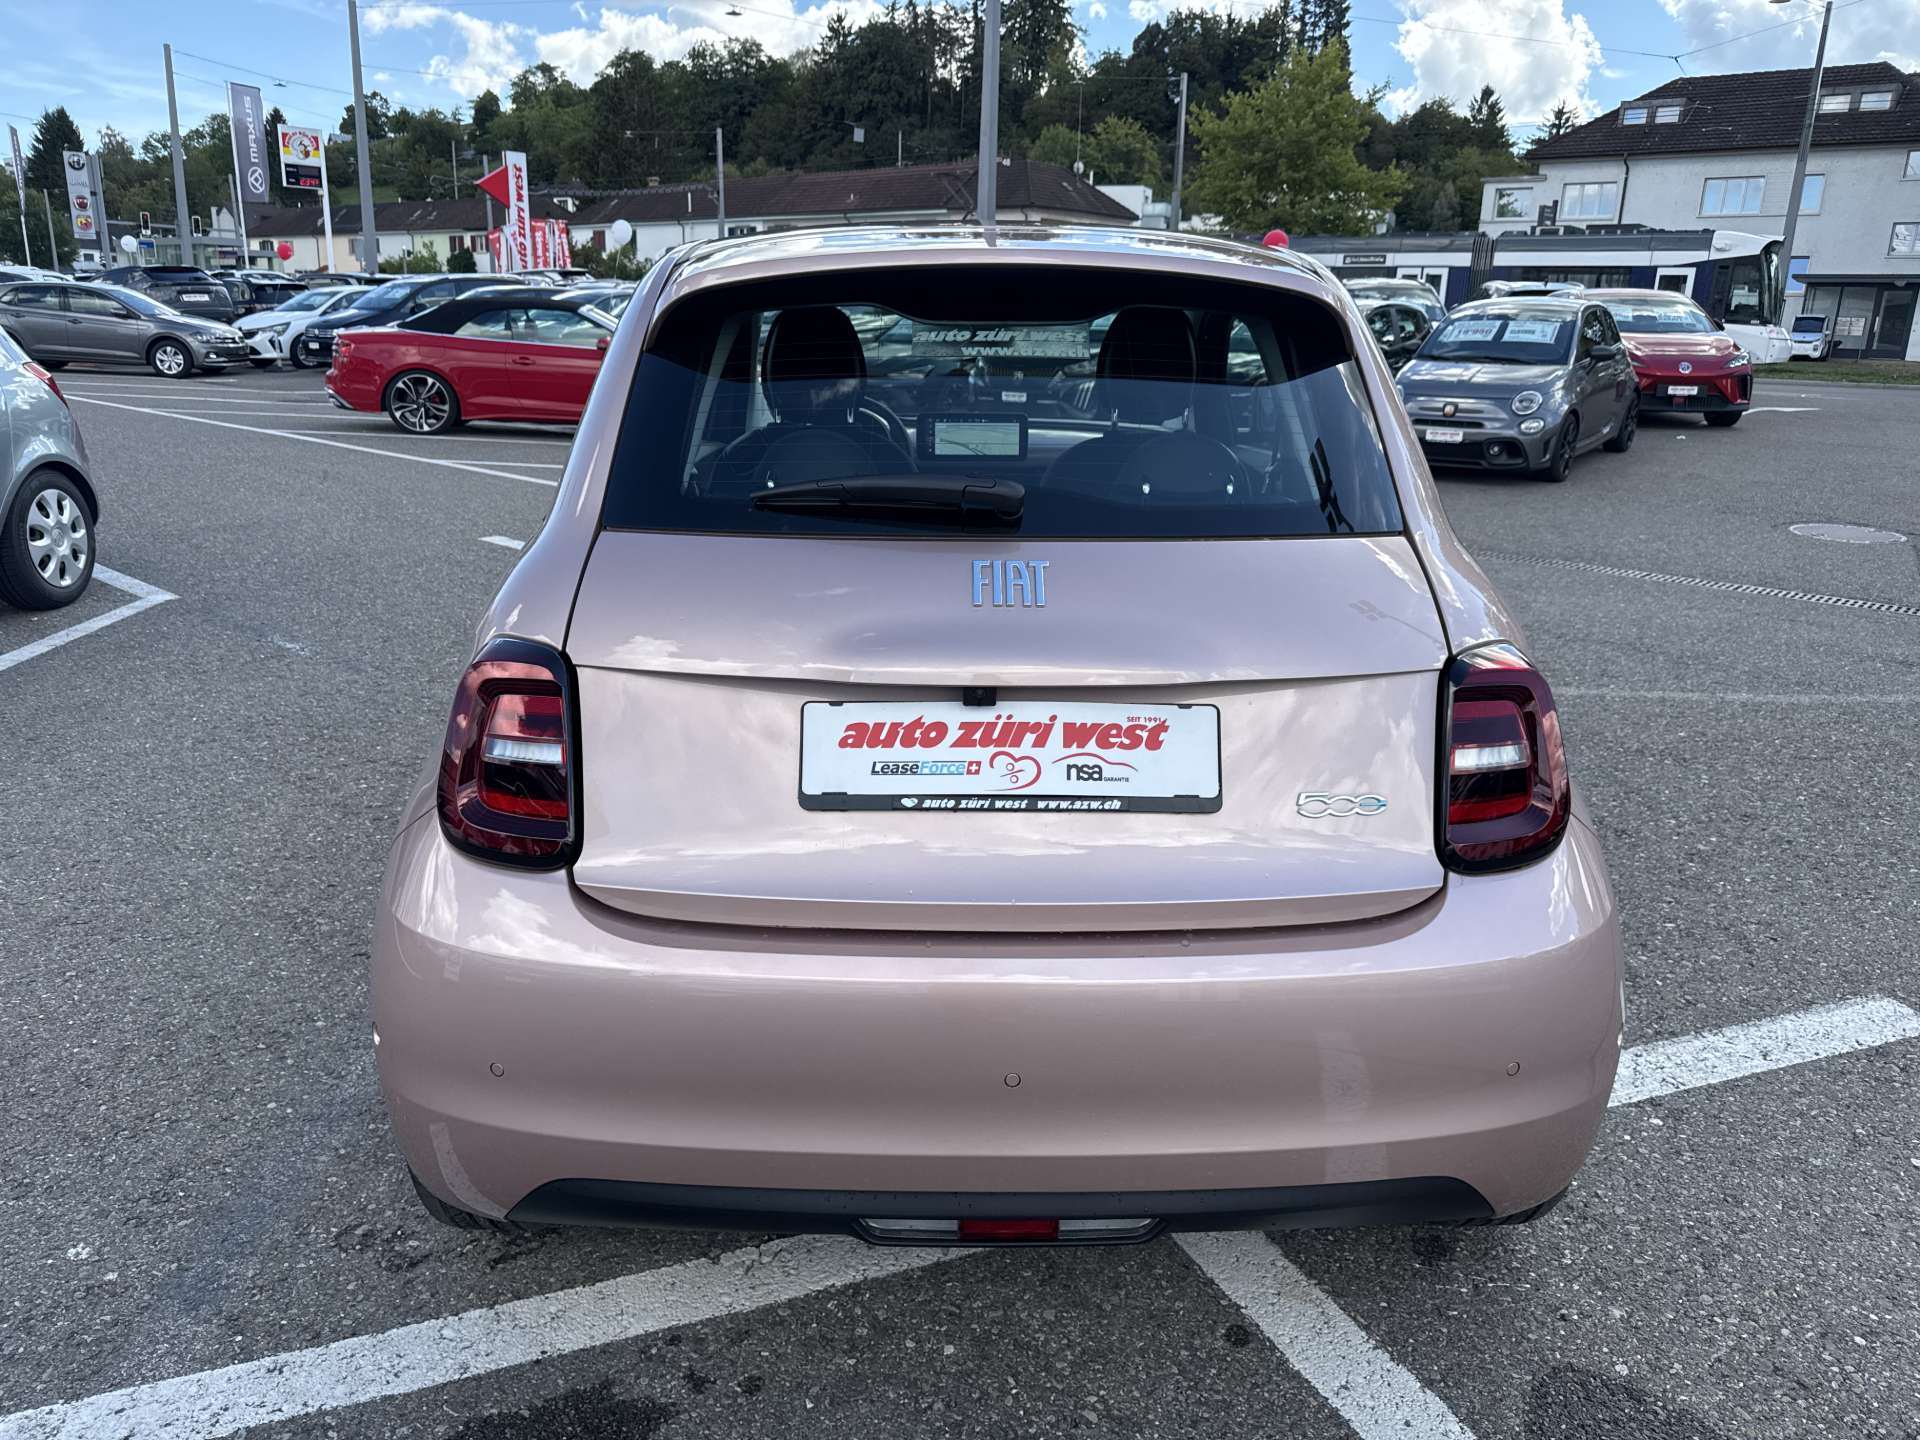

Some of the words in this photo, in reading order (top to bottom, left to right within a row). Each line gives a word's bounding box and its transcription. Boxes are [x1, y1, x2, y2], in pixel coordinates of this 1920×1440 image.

[244, 95, 259, 163] MAXUS
[513, 163, 525, 203] west
[913, 327, 972, 342] auto
[972, 327, 1026, 342] züri
[1030, 328, 1089, 342] west
[972, 559, 1050, 607] FIAT
[1143, 716, 1162, 724] 1991
[837, 714, 949, 749] auto
[949, 713, 1058, 749] züri
[1062, 718, 1170, 751] west
[871, 760, 966, 775] LeaseForce
[1066, 763, 1103, 782] nsa
[921, 797, 956, 809] auto
[958, 797, 992, 809] züri
[994, 797, 1028, 809] west
[1037, 798, 1122, 810] www.azw.ch
[1296, 791, 1388, 818] 500
